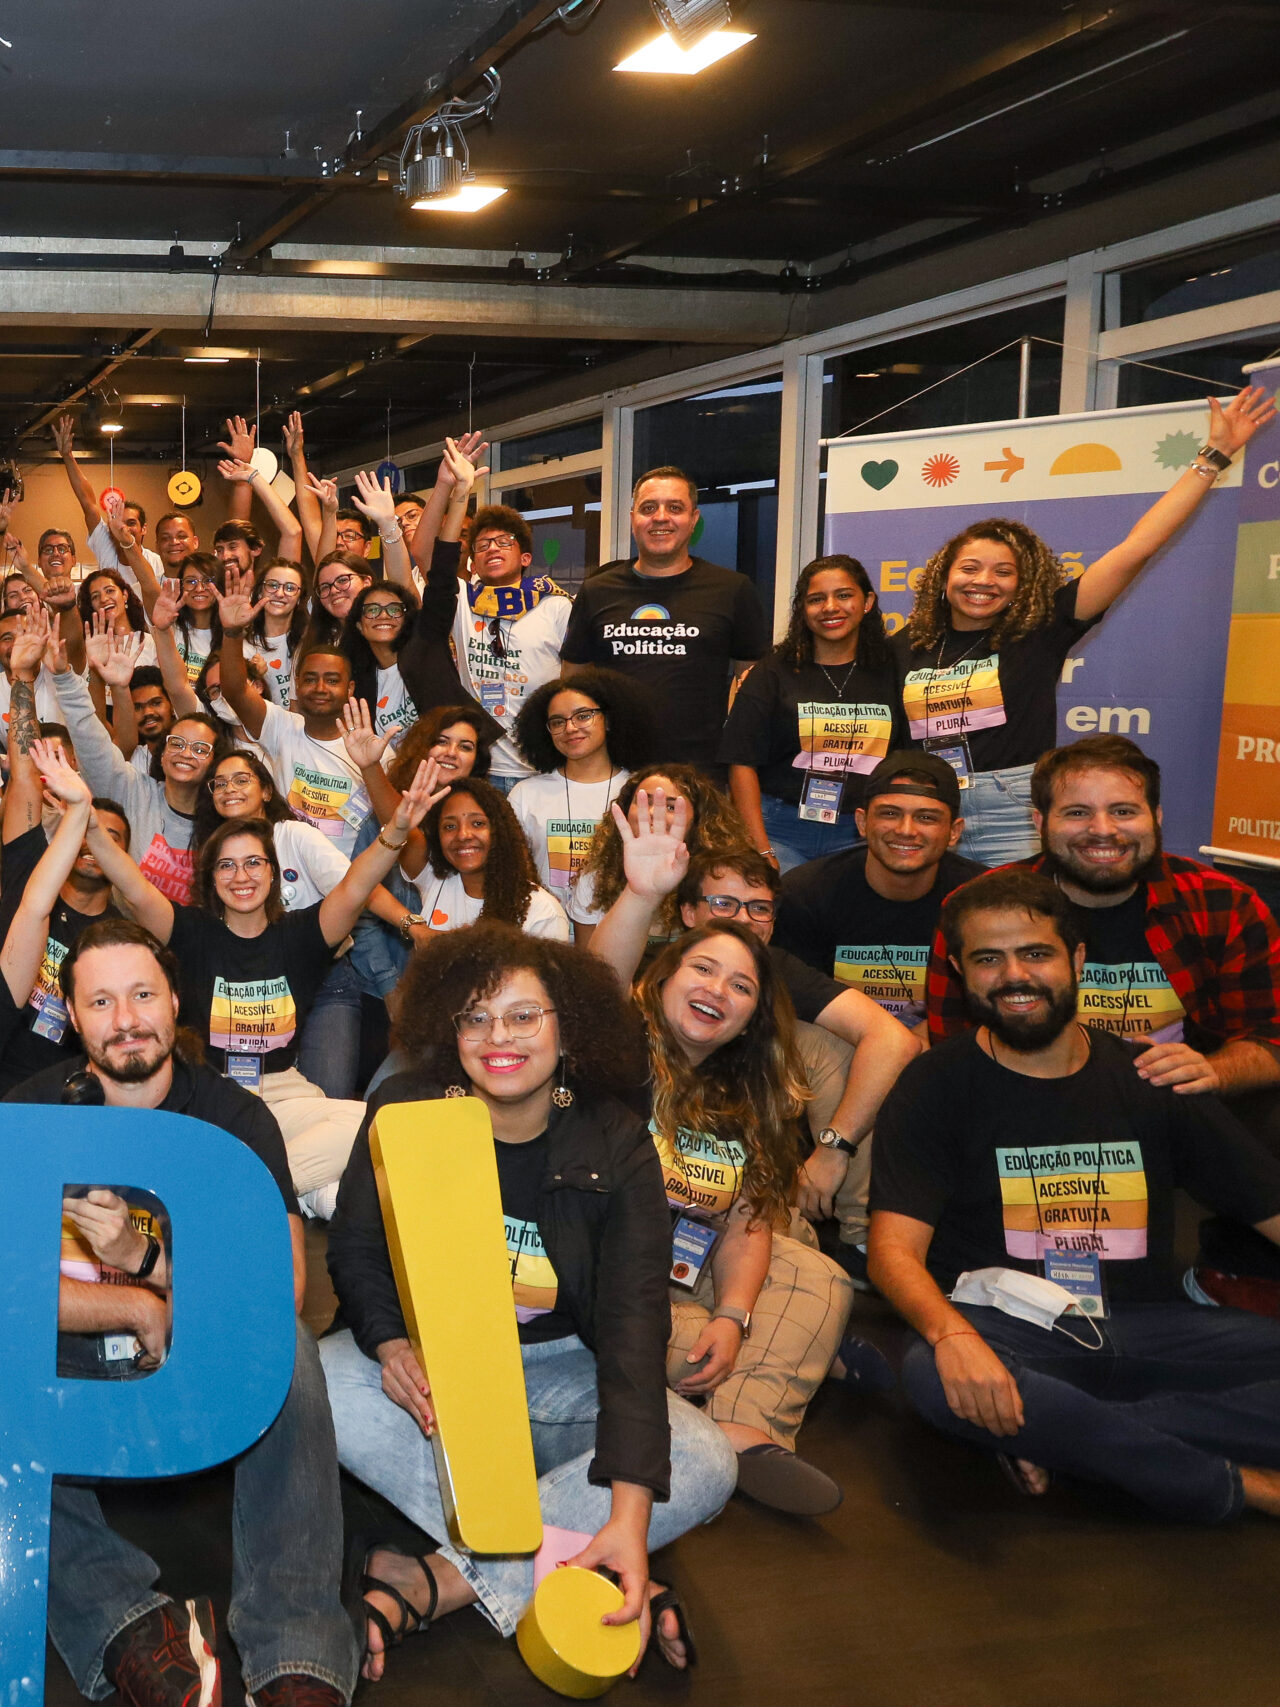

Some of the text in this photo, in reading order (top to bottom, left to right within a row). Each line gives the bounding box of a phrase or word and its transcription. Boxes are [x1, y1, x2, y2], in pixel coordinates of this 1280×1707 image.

[604, 623, 700, 640] Educação
[469, 637, 521, 658] Ensar
[612, 640, 687, 655] Política
[476, 670, 499, 679] um
[923, 679, 972, 696] ACESSÍVEL
[803, 705, 887, 717] EDUCAÇÃO POLÍTICA
[928, 696, 973, 713] GRATUITA
[936, 716, 972, 731] PLURAL
[1066, 704, 1151, 734] em
[824, 722, 869, 733] ACESSÍVEL
[823, 740, 864, 750] GRATUITA
[824, 757, 854, 767] PLURAL
[551, 822, 592, 834] EDUCAÇÃO
[841, 948, 928, 962] EDUCAÇÃO POLÍTI
[863, 967, 917, 981] ACESSÍVEL
[1079, 967, 1169, 985] CAÇÃO POLÍTIC
[864, 986, 913, 998] GRATUITA
[1084, 992, 1152, 1009] ACESSÍVEL
[234, 1003, 276, 1016] ACESSÍVEL
[235, 1022, 275, 1032] GRATUITA
[1089, 1018, 1153, 1033] GRATUITA
[1005, 1149, 1135, 1171] EDUCAÇÃO POLÍTICA
[1040, 1177, 1110, 1198] ACESSÍVEL
[1044, 1207, 1111, 1223] GRATUITA
[1054, 1234, 1109, 1252] PLURAL
